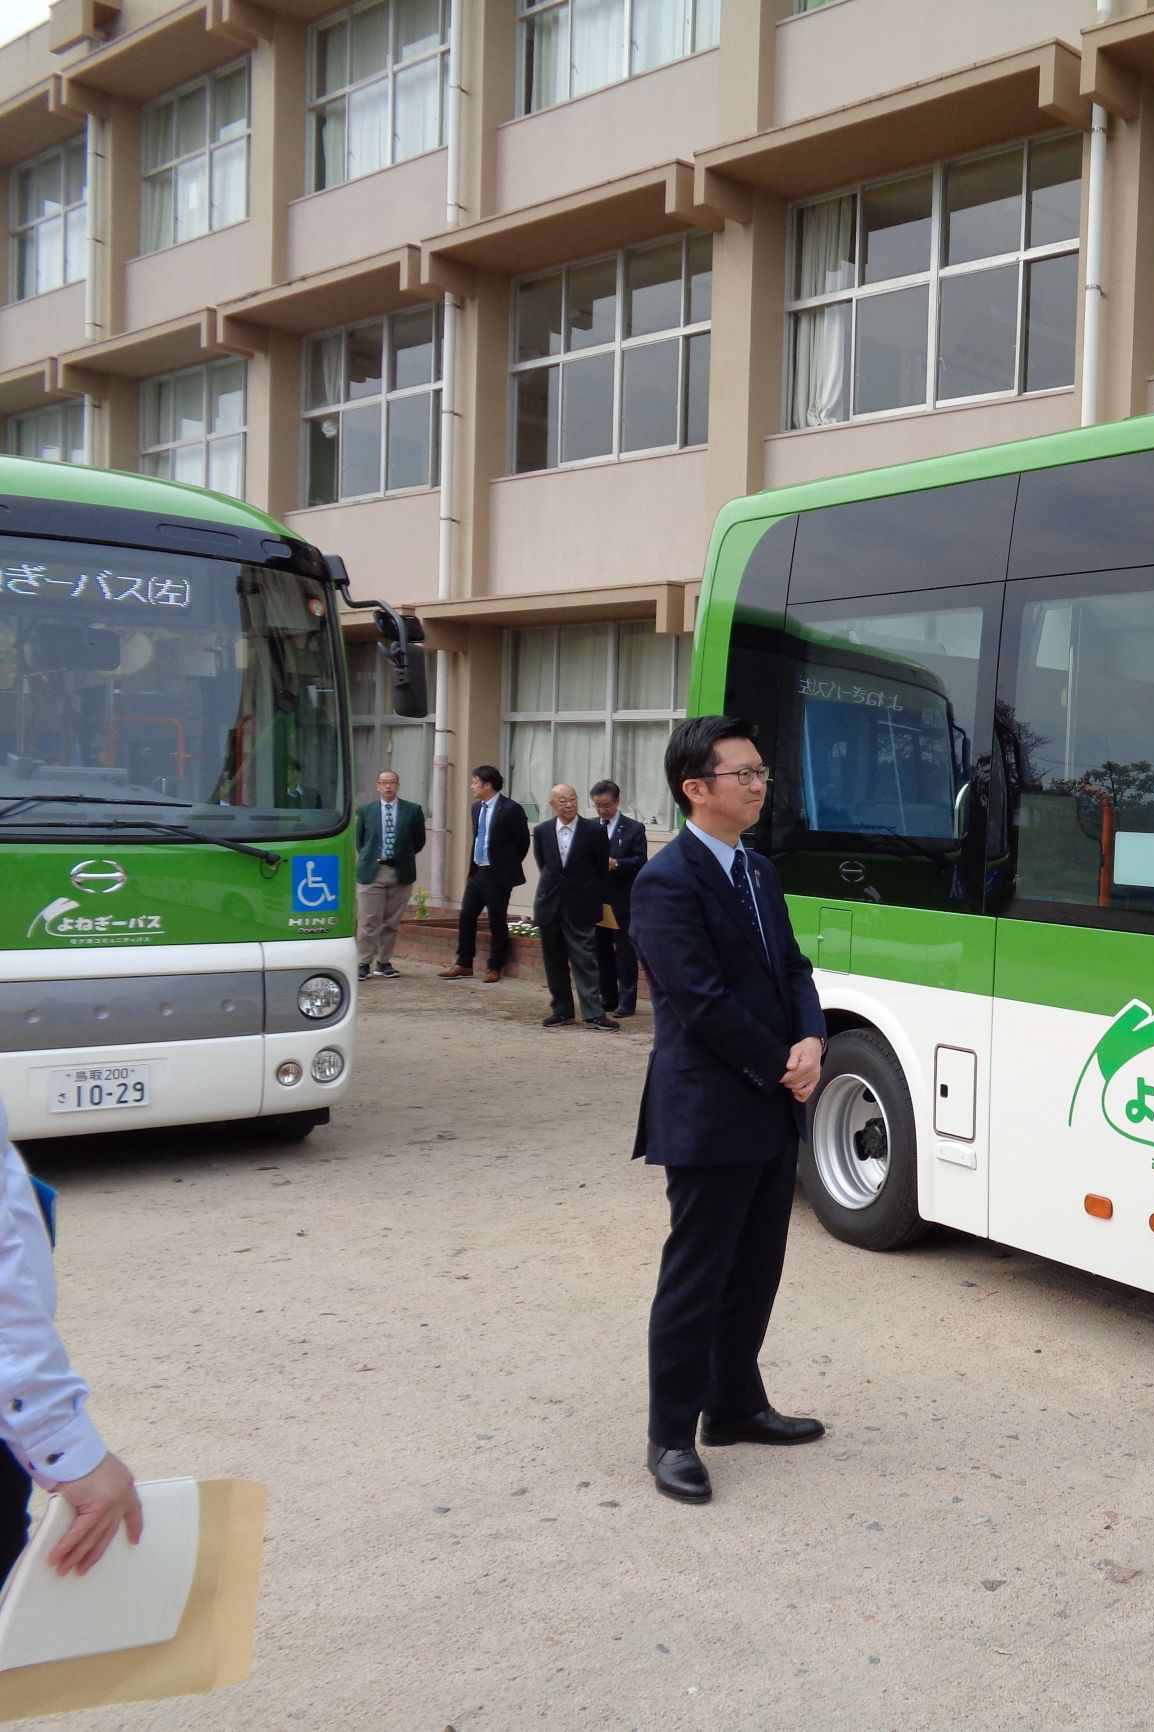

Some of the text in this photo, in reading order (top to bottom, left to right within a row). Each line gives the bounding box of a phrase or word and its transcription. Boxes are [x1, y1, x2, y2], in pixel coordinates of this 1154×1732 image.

[0, 564, 190, 607] ぎーバス(左)
[57, 914, 161, 932] よねぎーバス
[288, 916, 339, 927] HINO
[76, 1081, 145, 1108] 10-29
